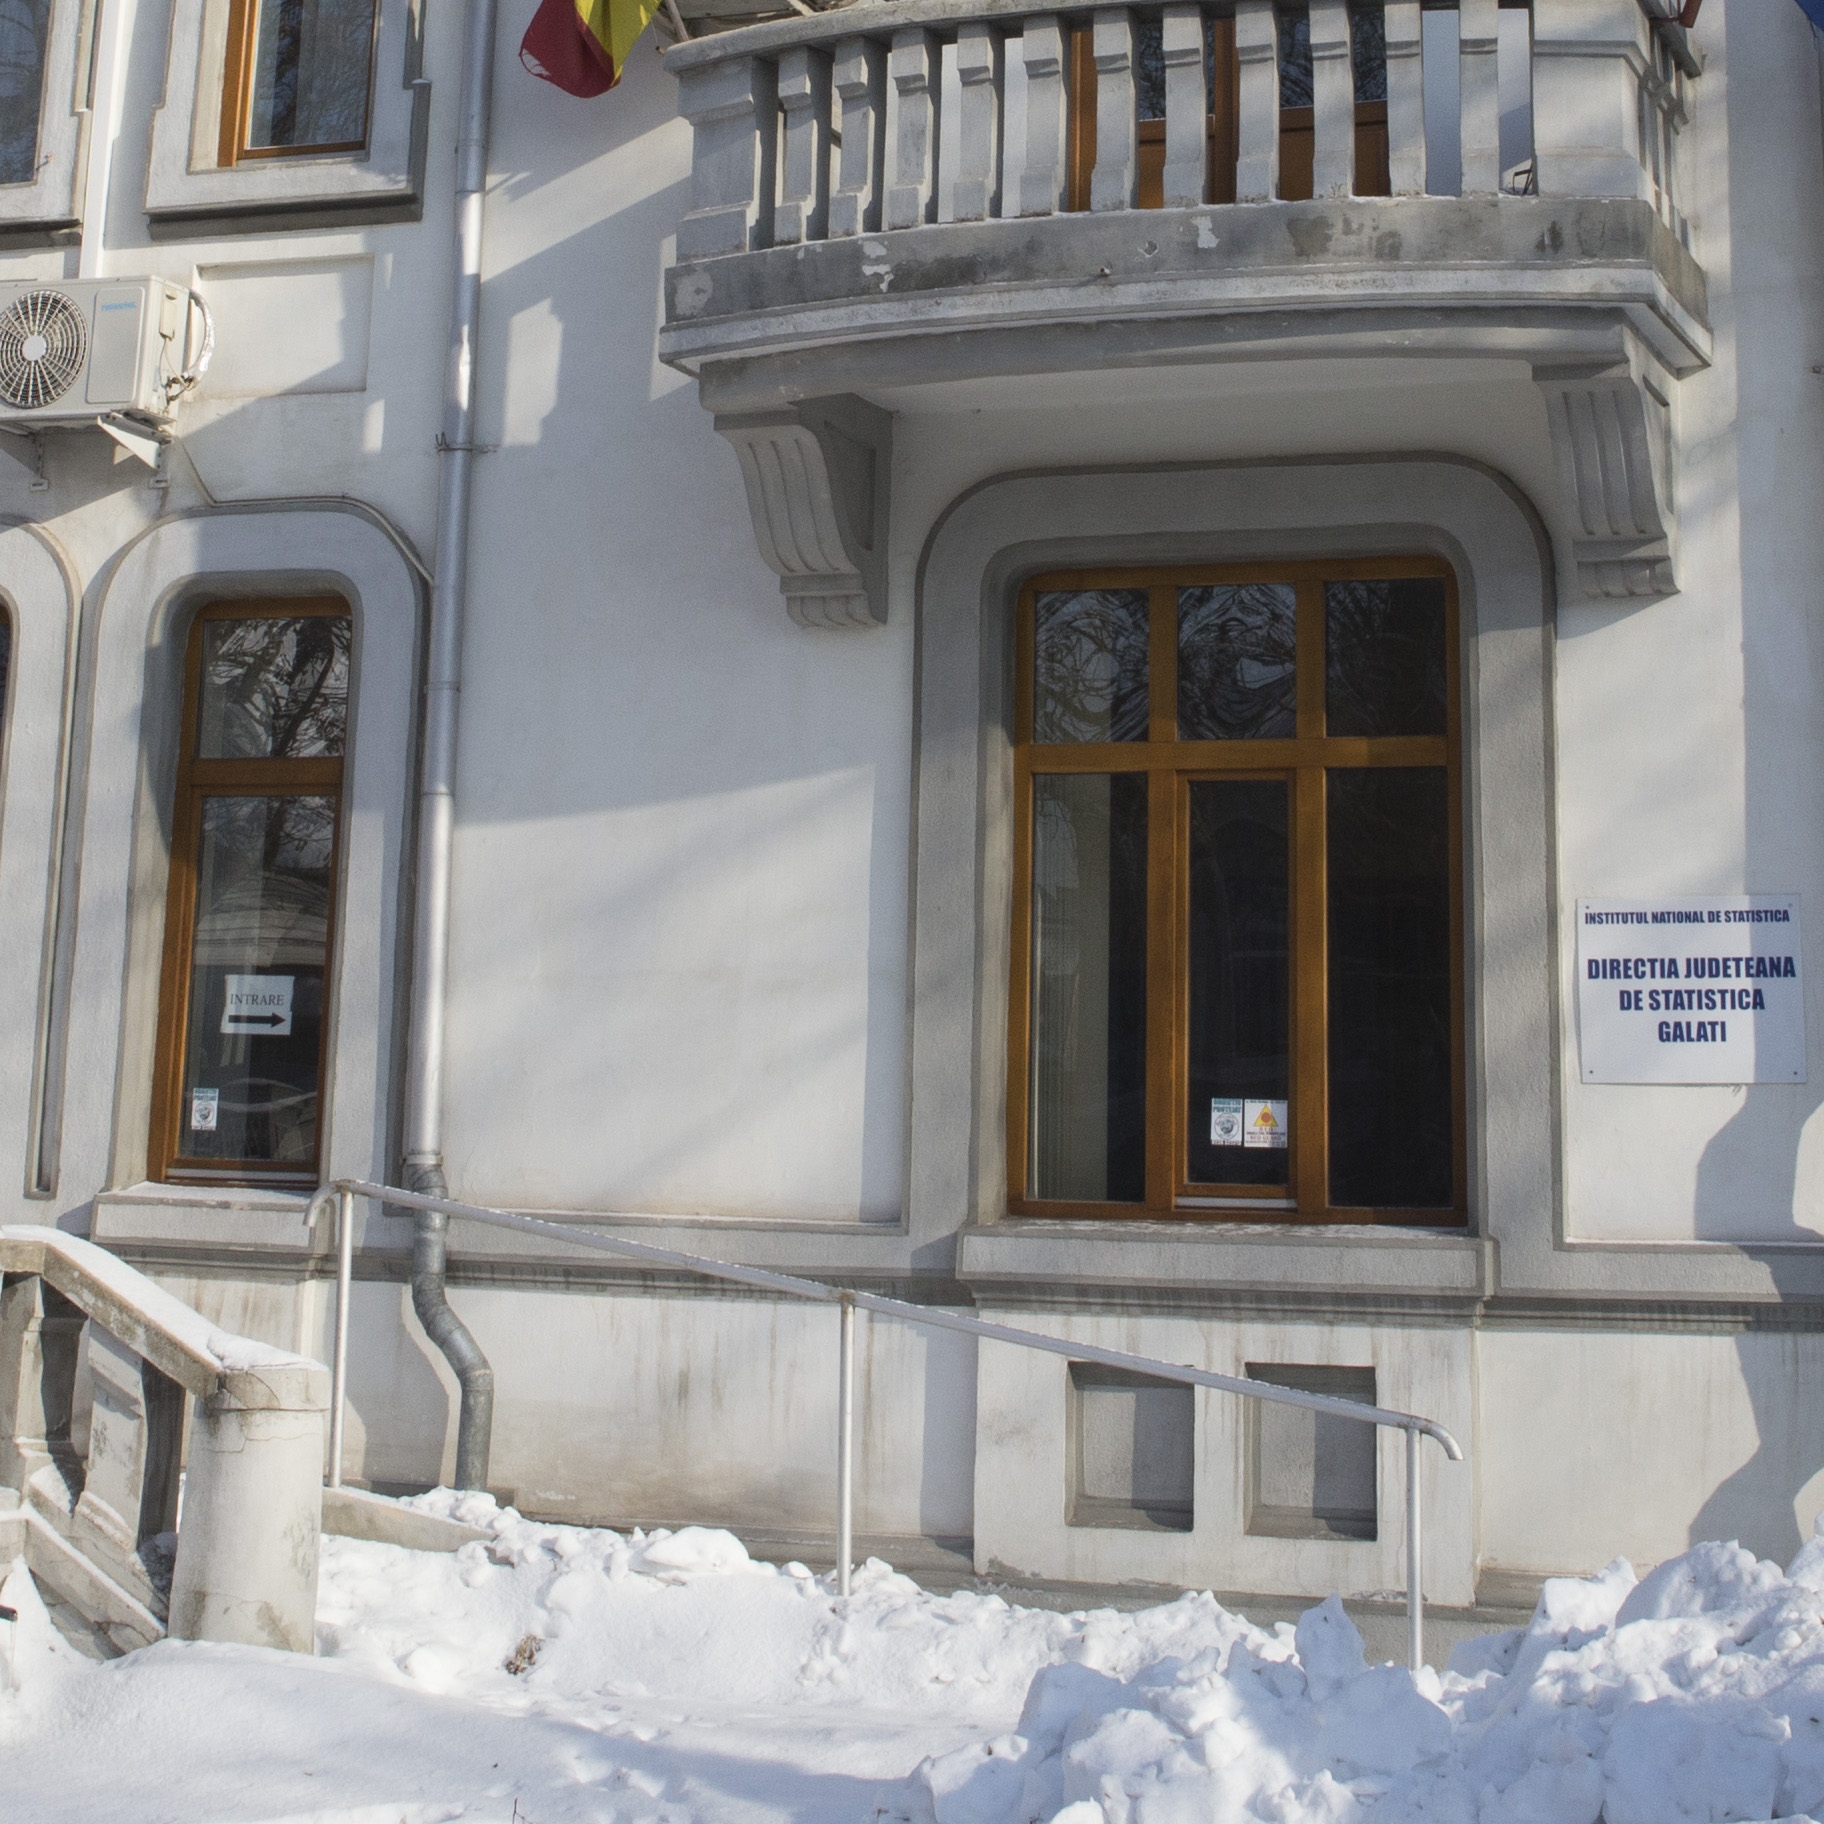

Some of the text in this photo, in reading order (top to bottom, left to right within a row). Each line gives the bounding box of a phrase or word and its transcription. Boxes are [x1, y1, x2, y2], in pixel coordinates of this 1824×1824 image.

[1584, 909, 1790, 925] INSTITUTUL NATIONAL DE STATISTICA
[1587, 956, 1796, 979] DIRECTIA JUDETEANA
[229, 993, 285, 1006] INTRARE
[1619, 988, 1765, 1011] DE STATISTICA
[1658, 1021, 1727, 1042] GALATI
